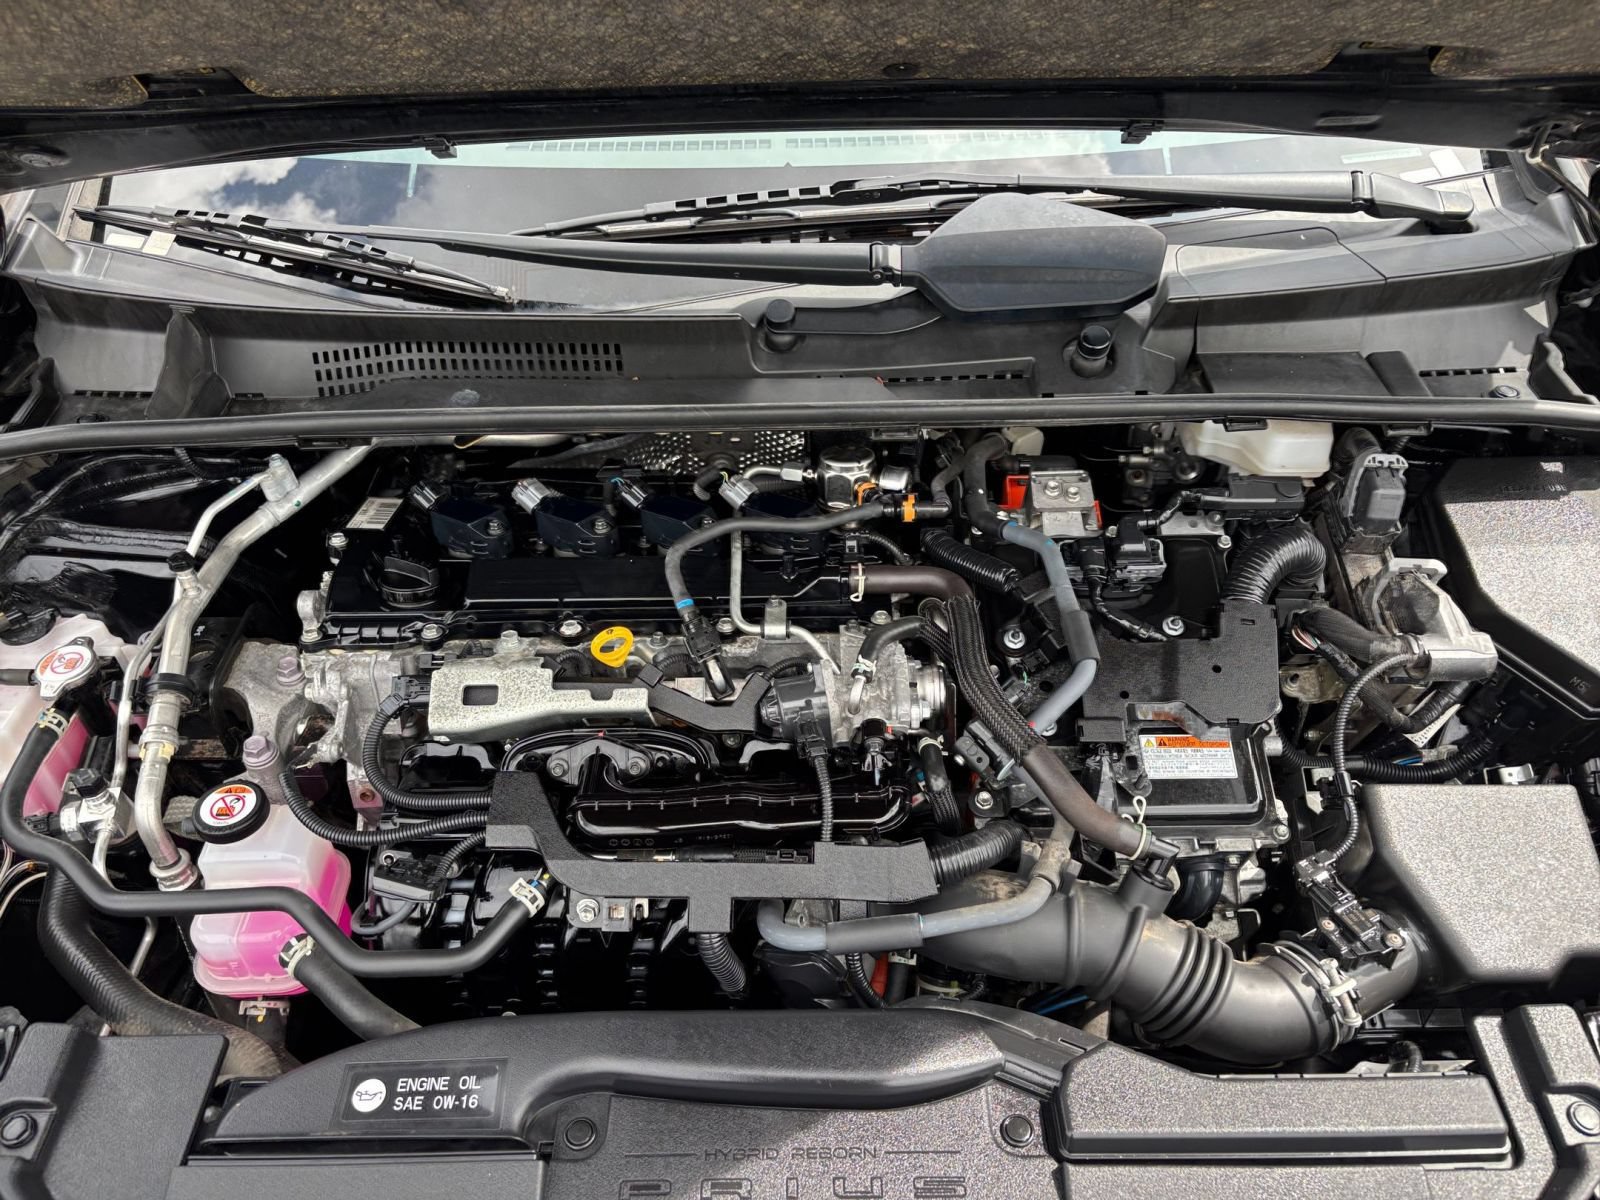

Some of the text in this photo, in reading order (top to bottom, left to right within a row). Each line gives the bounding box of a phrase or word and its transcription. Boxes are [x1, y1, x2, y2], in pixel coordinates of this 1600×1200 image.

[397, 1075, 481, 1092] ENGINE OIL
[393, 1094, 479, 1111] SAE 0W-16
[704, 1146, 877, 1161] HYBRID REBORN
[618, 1178, 967, 1200] PRIUS
